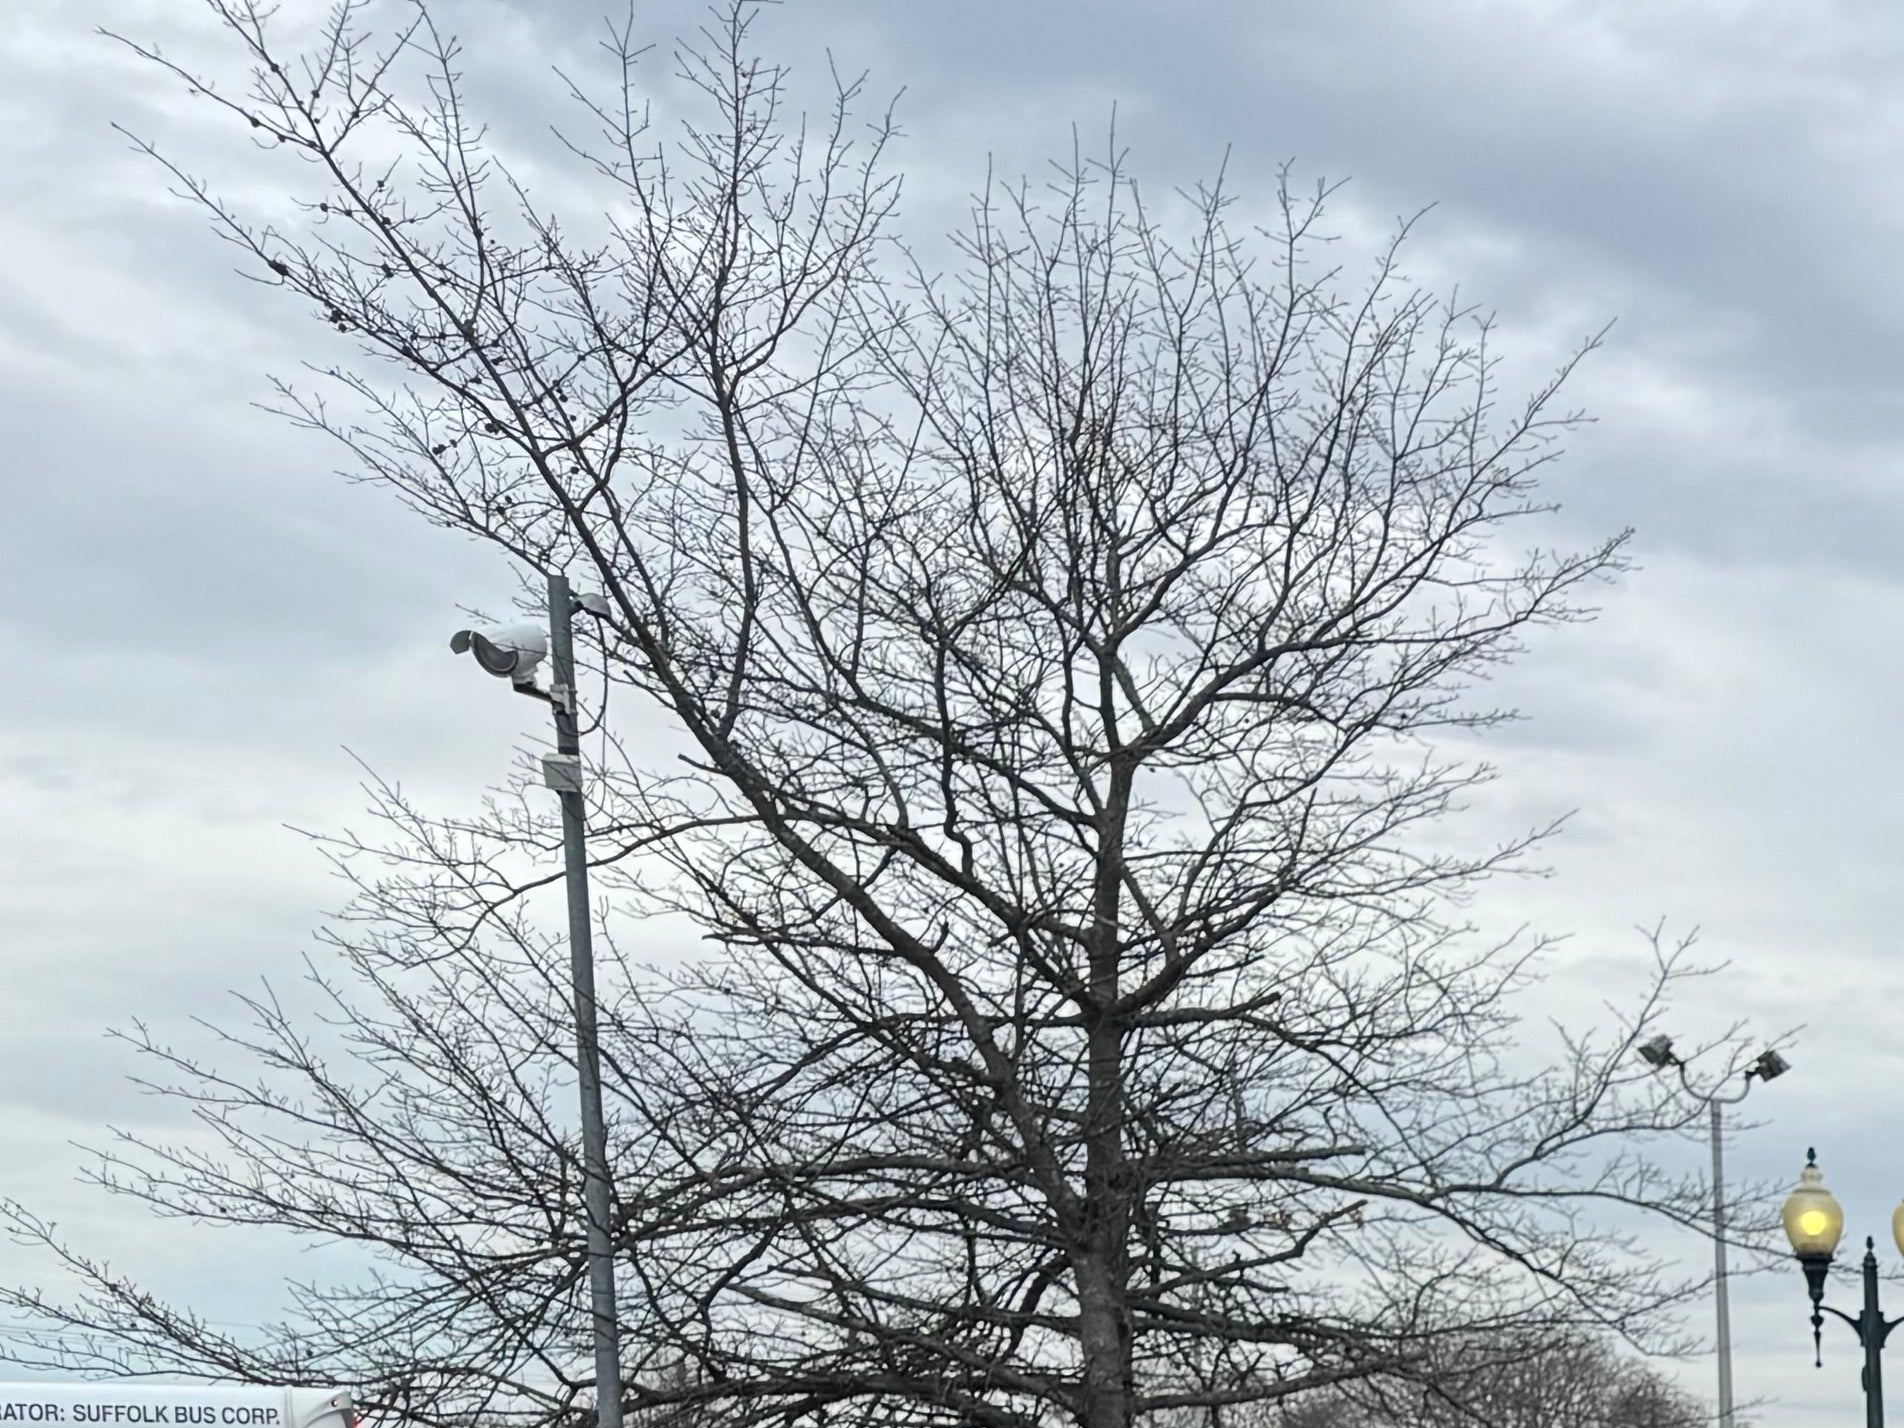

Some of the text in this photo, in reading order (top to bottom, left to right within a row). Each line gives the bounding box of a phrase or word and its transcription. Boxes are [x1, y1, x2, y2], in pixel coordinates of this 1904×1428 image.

[0, 1403, 280, 1425] ATOR: SUFFOLK BUS CORP.
